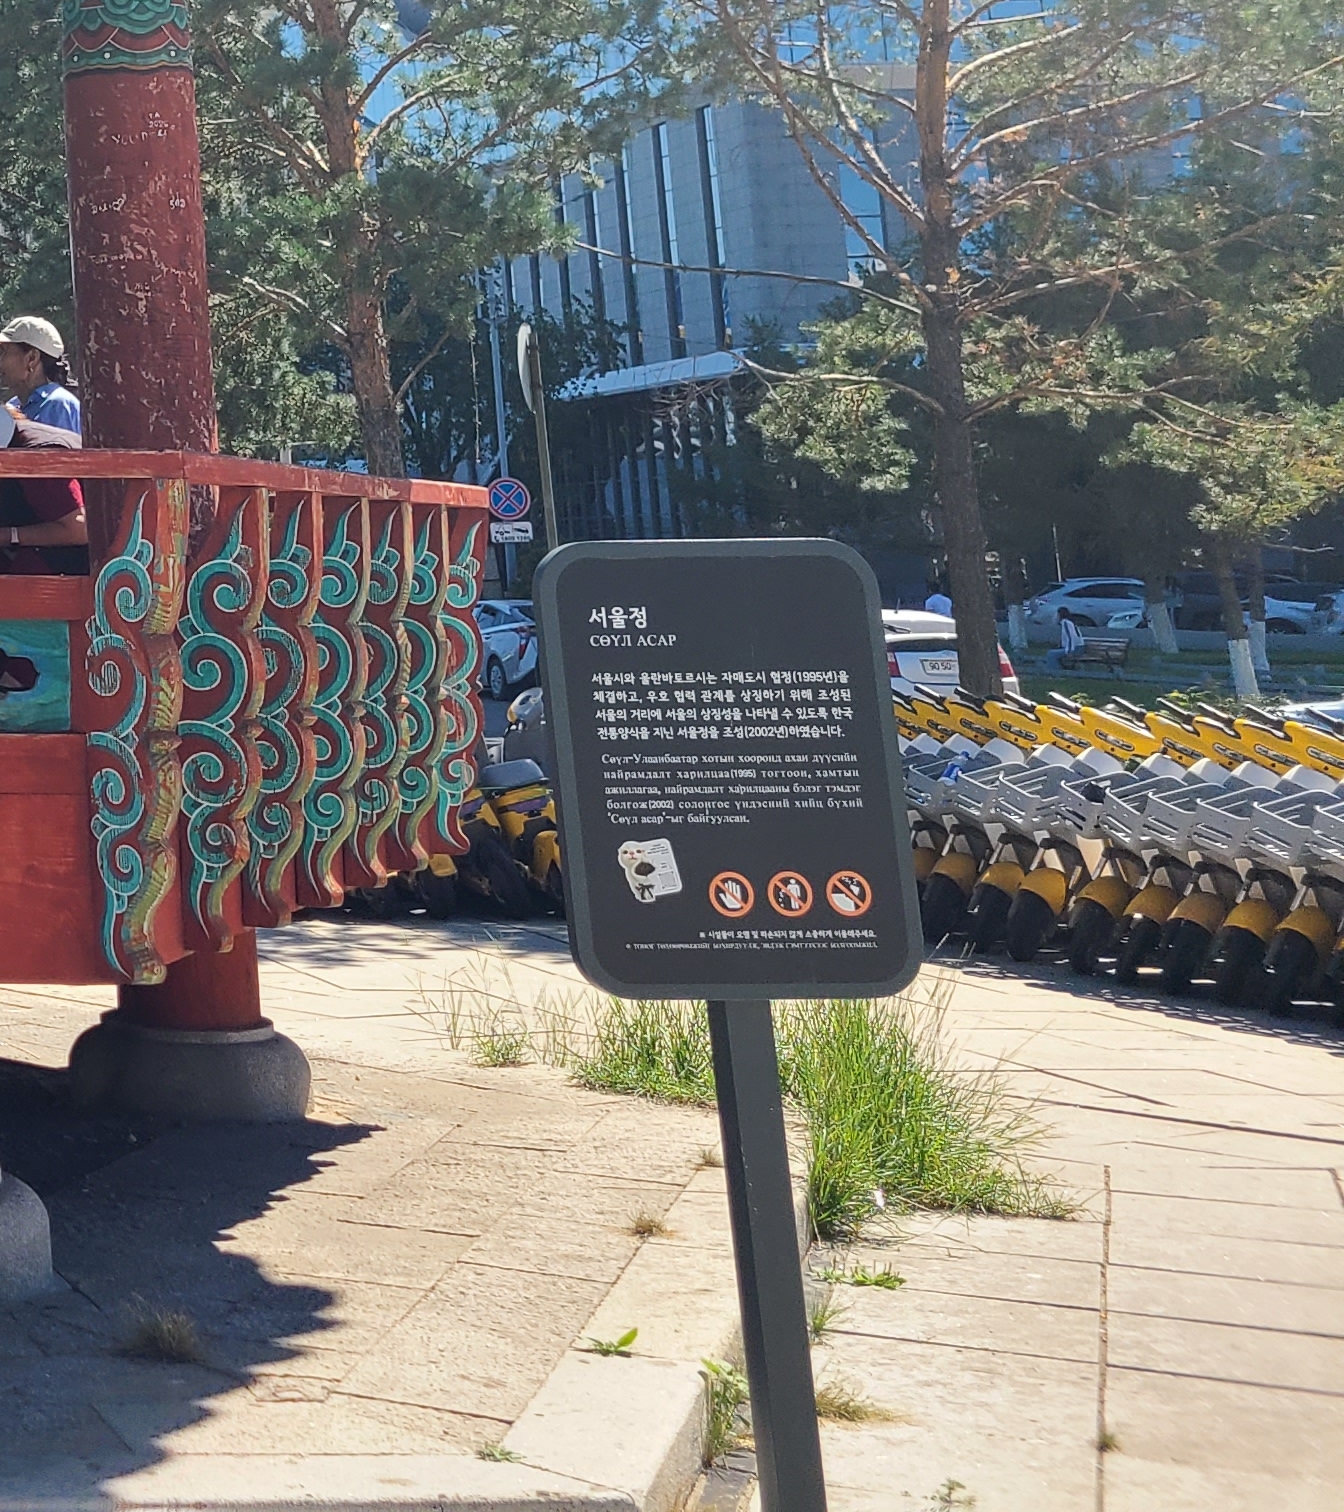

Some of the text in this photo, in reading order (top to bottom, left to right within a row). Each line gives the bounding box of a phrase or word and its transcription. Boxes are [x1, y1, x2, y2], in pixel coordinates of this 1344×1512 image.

[588, 606, 647, 629] 서울정
[590, 635, 676, 647] СӨҮЛ АСАР
[591, 670, 850, 685] 서울시와 울란바토르시는 자매도시 협정(1995년)을
[592, 688, 852, 704] 체결하고, 우호 협력 관계를 상징하기 위해 조성된
[594, 708, 628, 722] 서울의
[629, 708, 663, 722] 거리에
[665, 707, 698, 722] 서울의
[700, 707, 743, 721] 상징성을
[745, 707, 779, 721] 나타낼
[780, 707, 794, 720] 수
[795, 706, 829, 720] 있도록
[596, 726, 651, 741] 전통양식을
[652, 726, 674, 740] 지닌
[701, 755, 735, 763] хотын
[826, 797, 864, 809] бүхий
